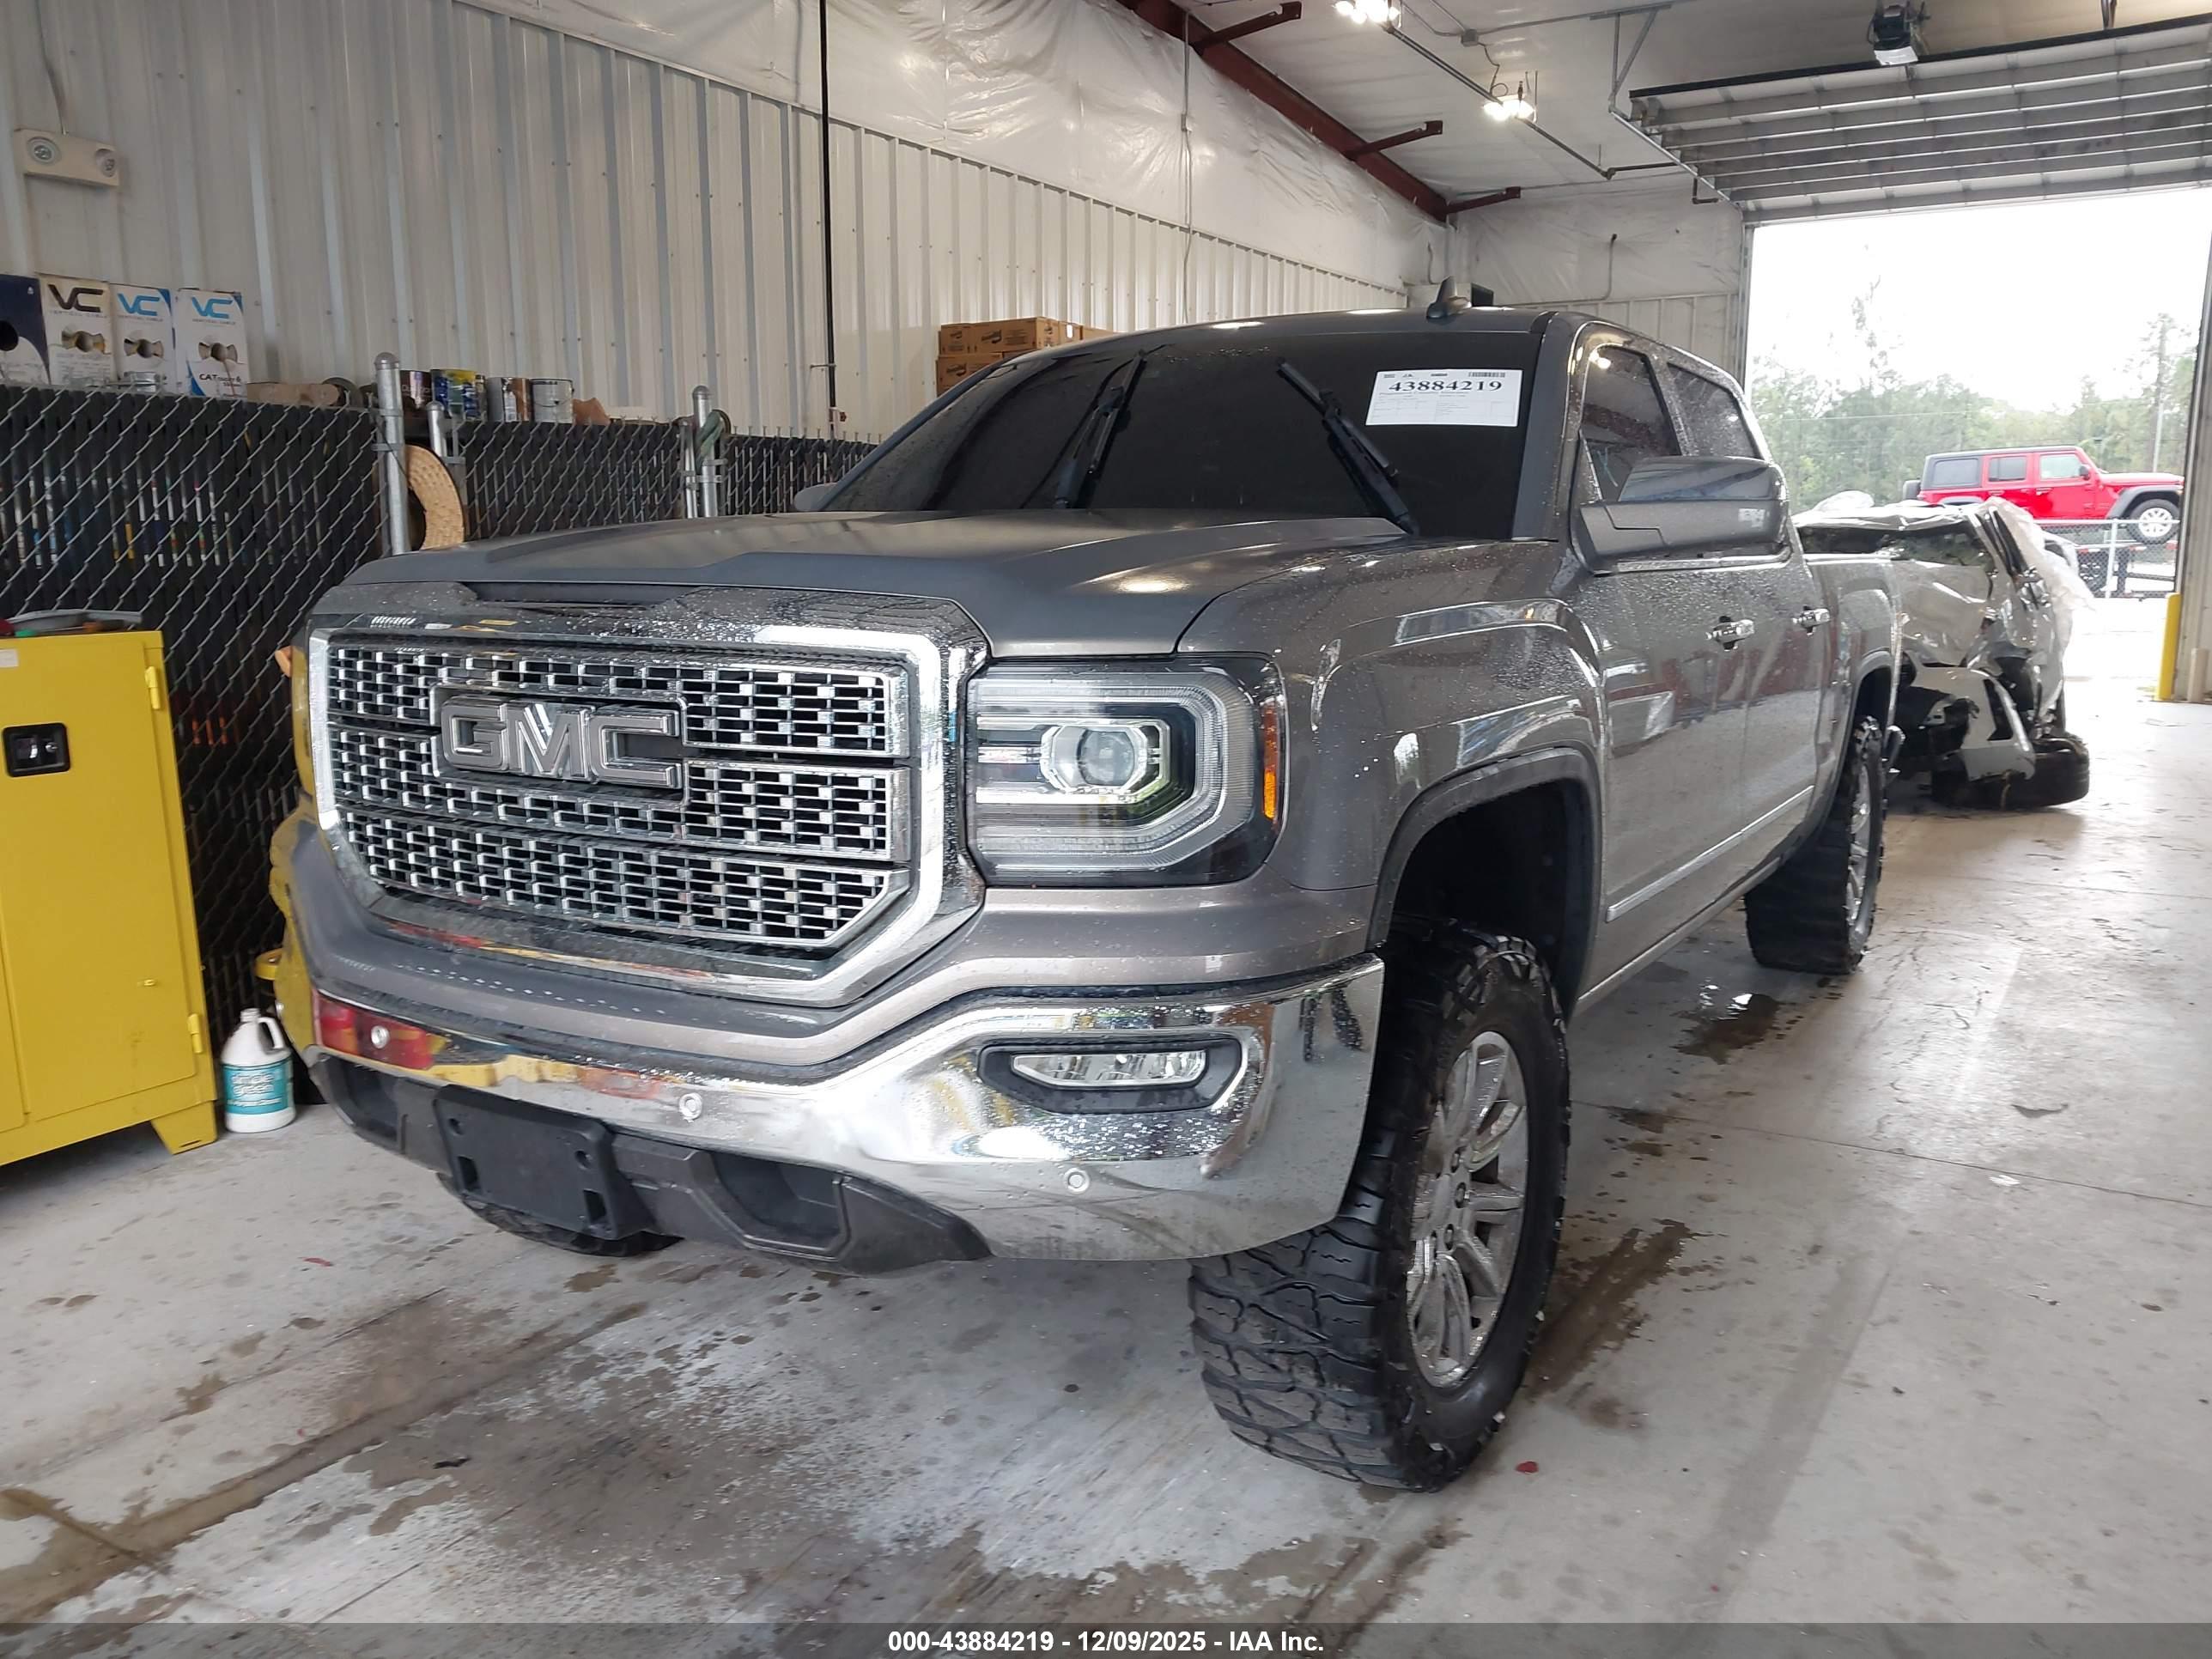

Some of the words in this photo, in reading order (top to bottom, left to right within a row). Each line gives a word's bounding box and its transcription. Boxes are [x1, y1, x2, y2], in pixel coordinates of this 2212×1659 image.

[47, 284, 104, 313] VC
[117, 293, 161, 317] VC
[191, 296, 234, 319] VC
[1388, 380, 1503, 392] 43884219
[441, 696, 683, 789] GMC
